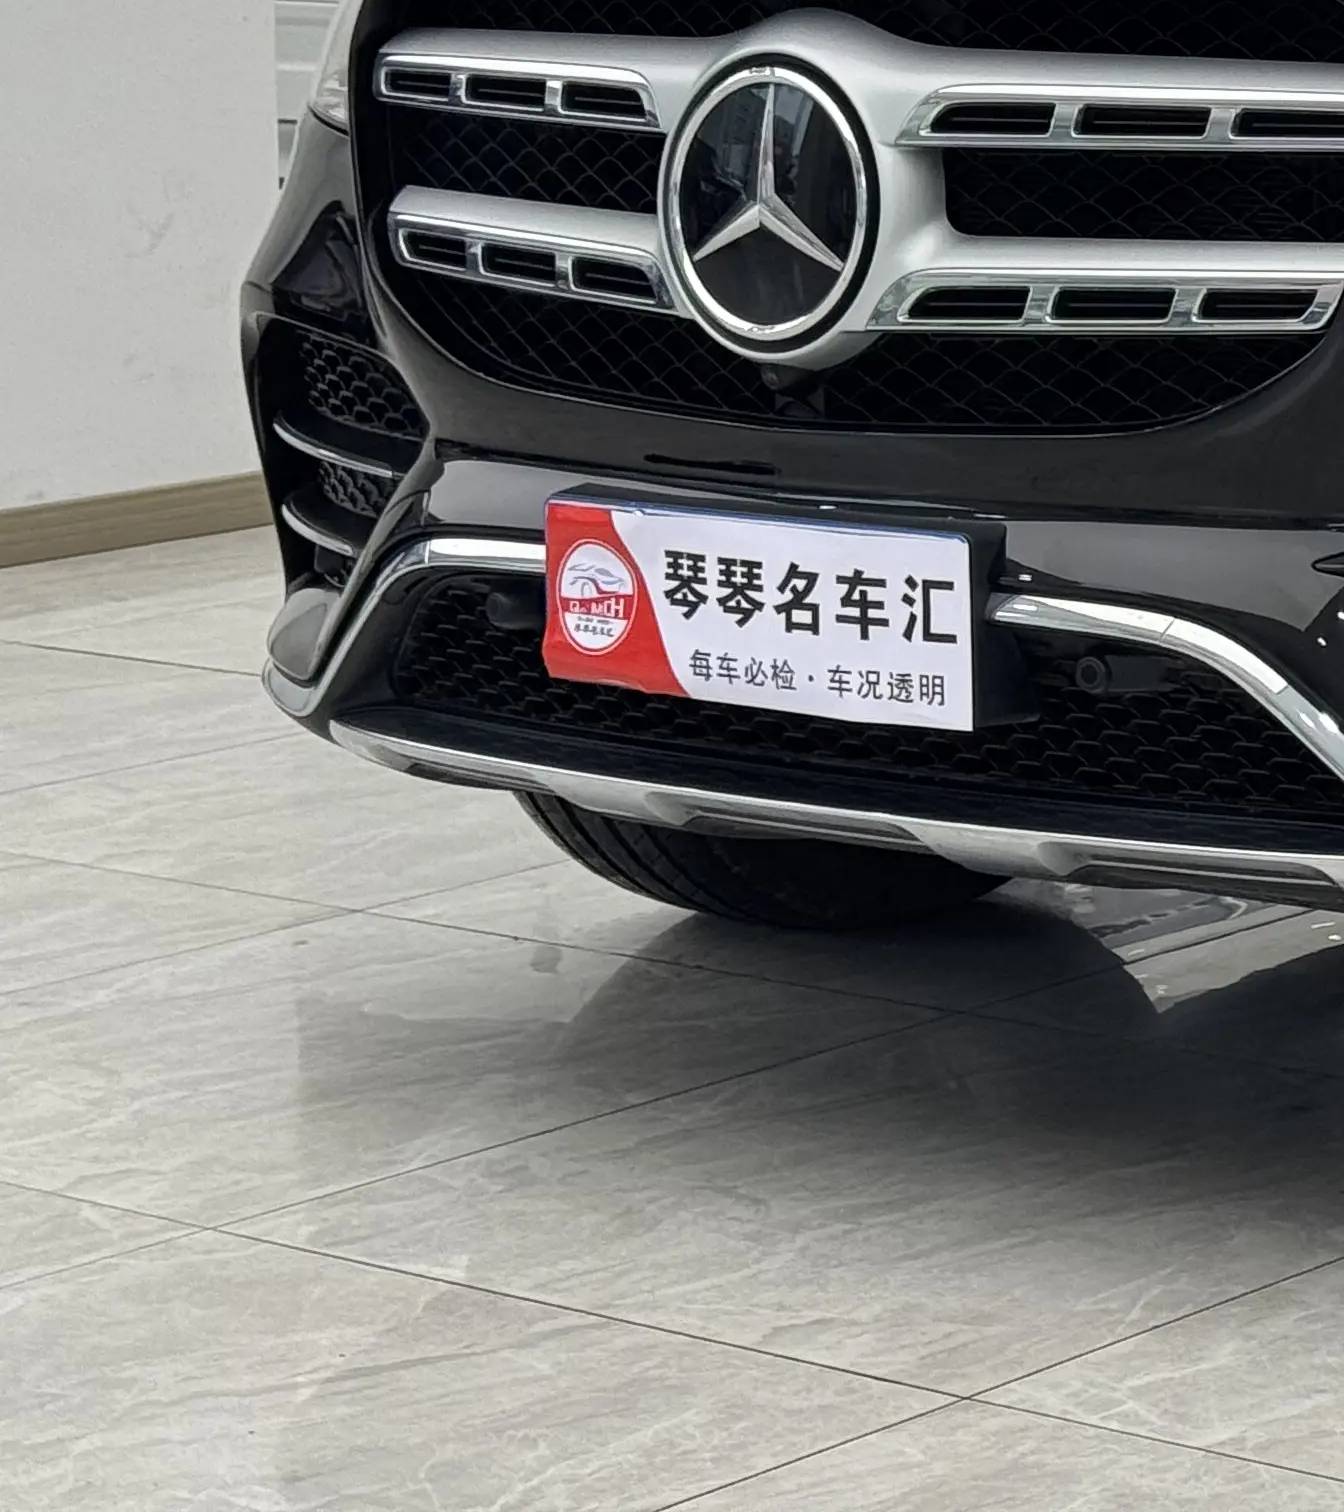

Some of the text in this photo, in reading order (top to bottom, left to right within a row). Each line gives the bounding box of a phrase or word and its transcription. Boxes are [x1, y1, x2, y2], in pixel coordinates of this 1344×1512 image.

[664, 549, 958, 644] 琴琴名车汇
